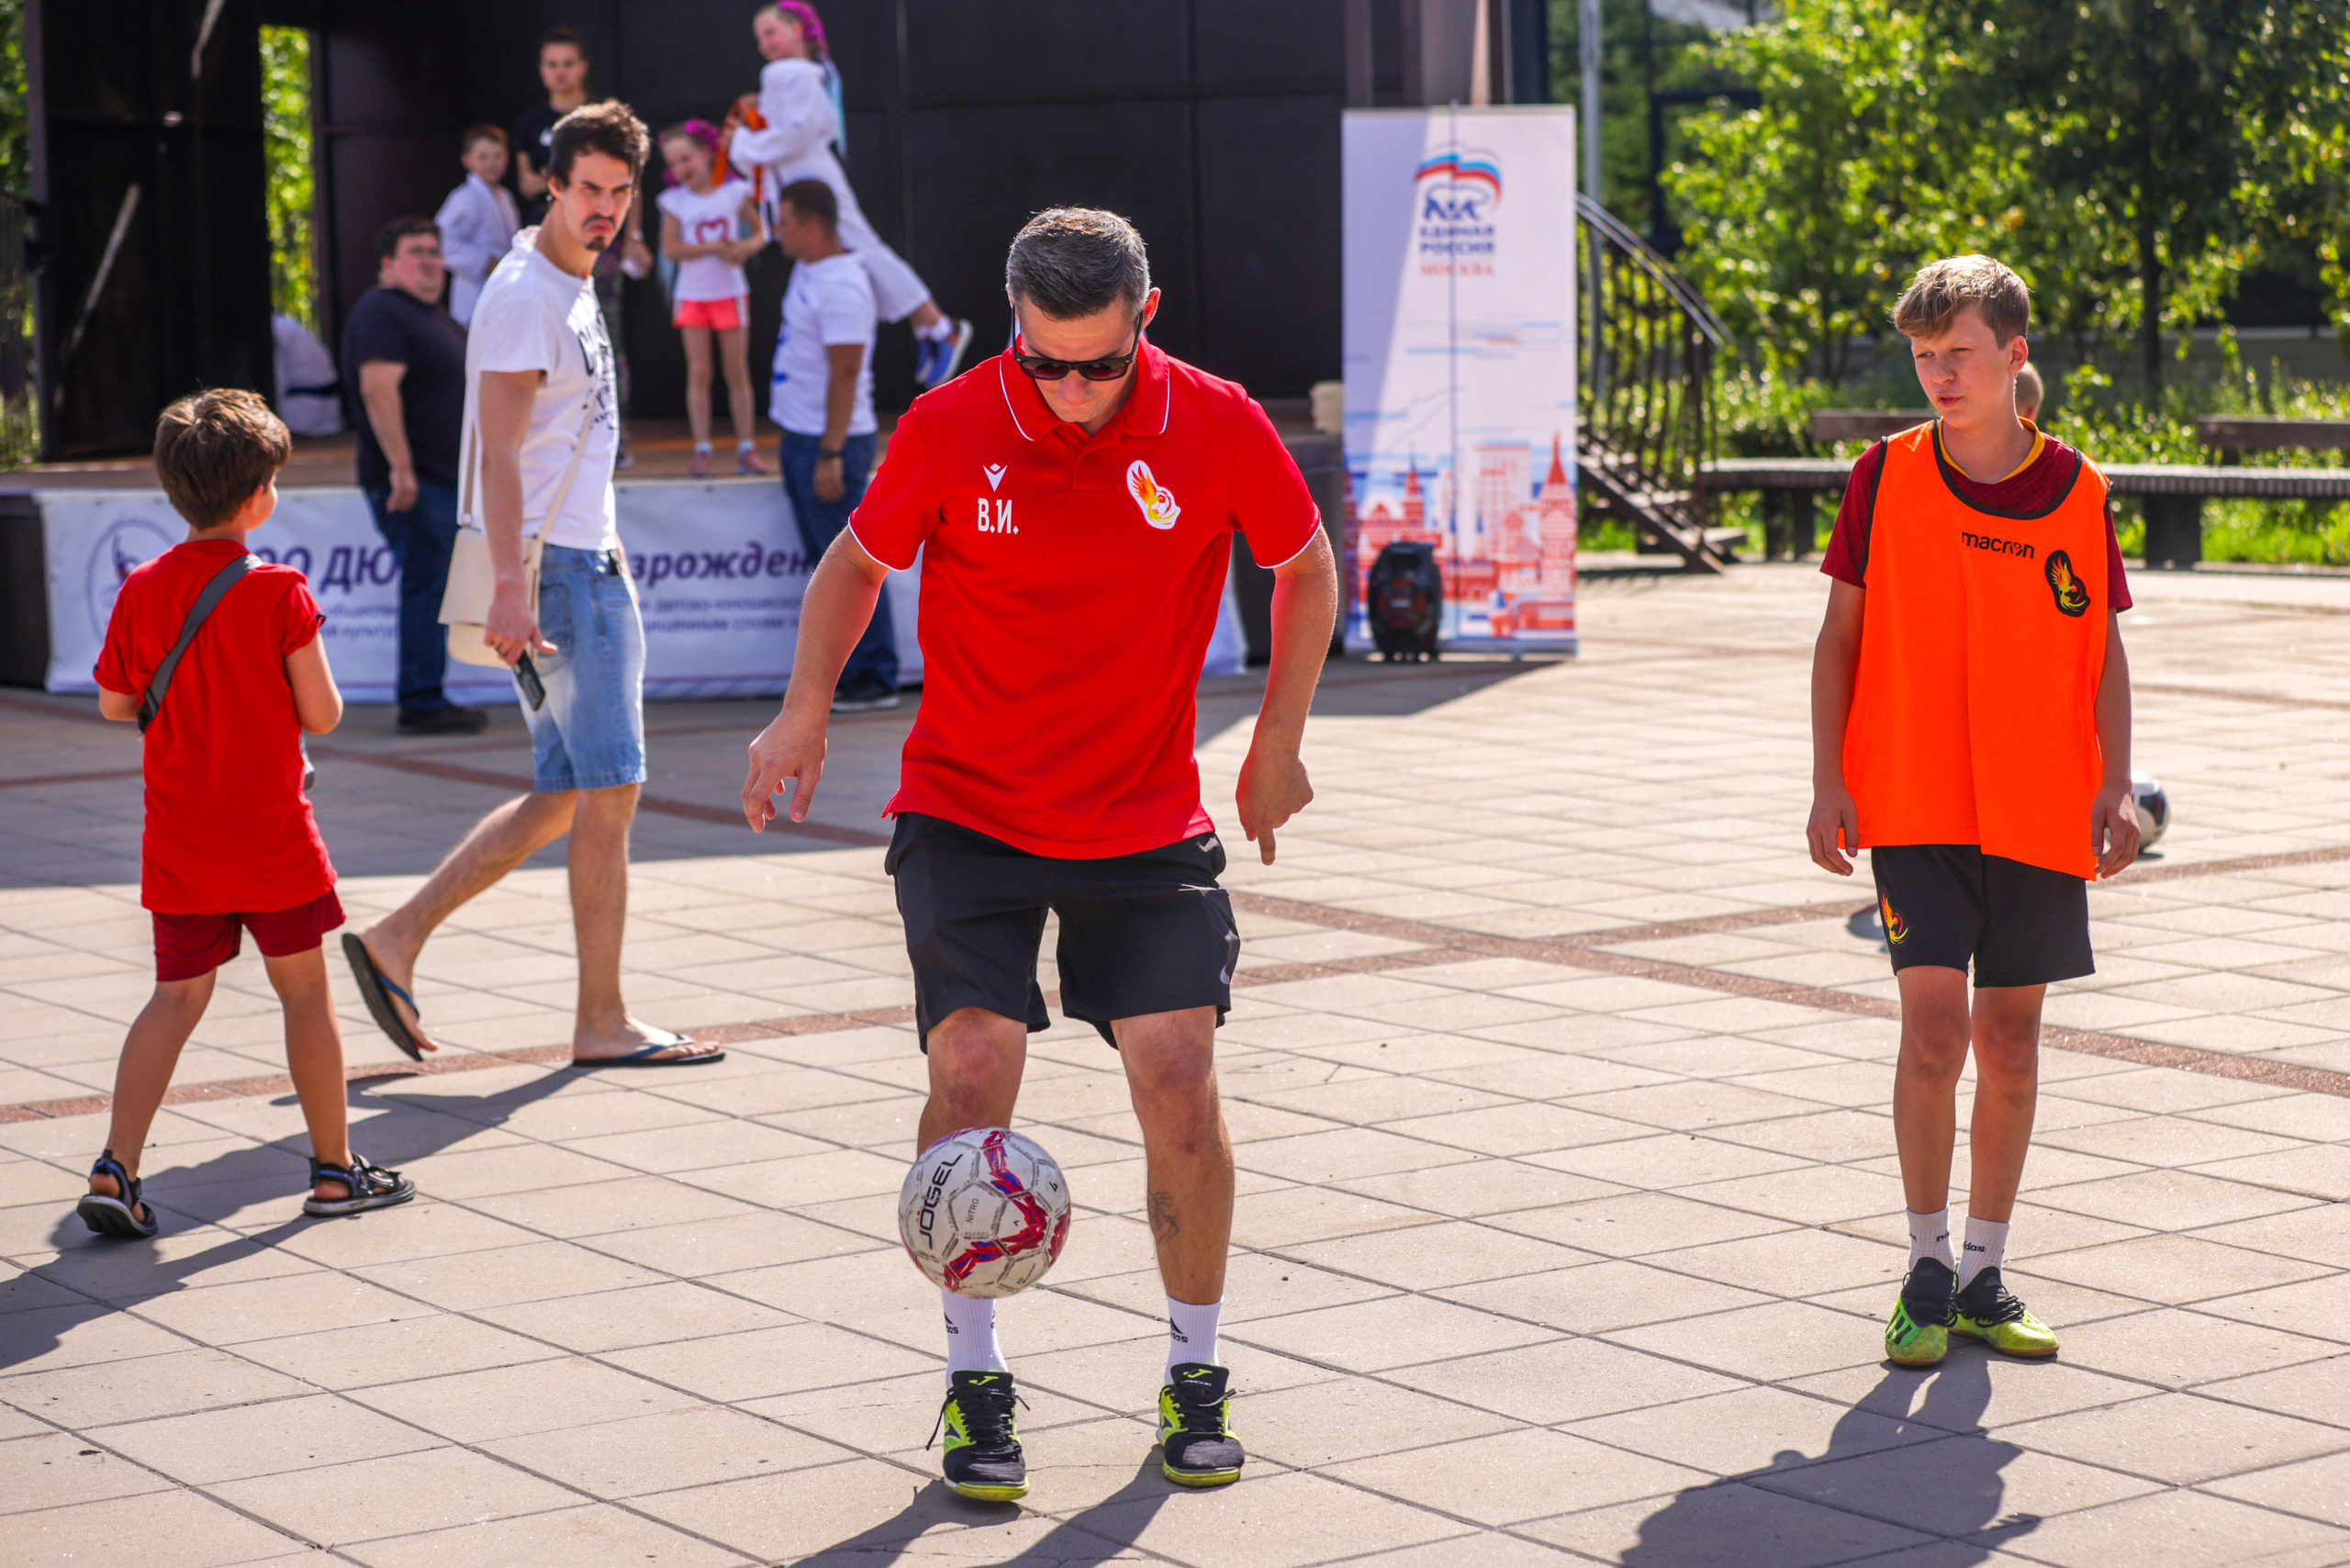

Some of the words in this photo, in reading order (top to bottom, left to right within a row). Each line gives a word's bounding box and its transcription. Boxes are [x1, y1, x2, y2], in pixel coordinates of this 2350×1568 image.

[978, 498, 1019, 534] В.И.
[1962, 532, 2035, 559] macron
[966, 1198, 979, 1223] NITRO
